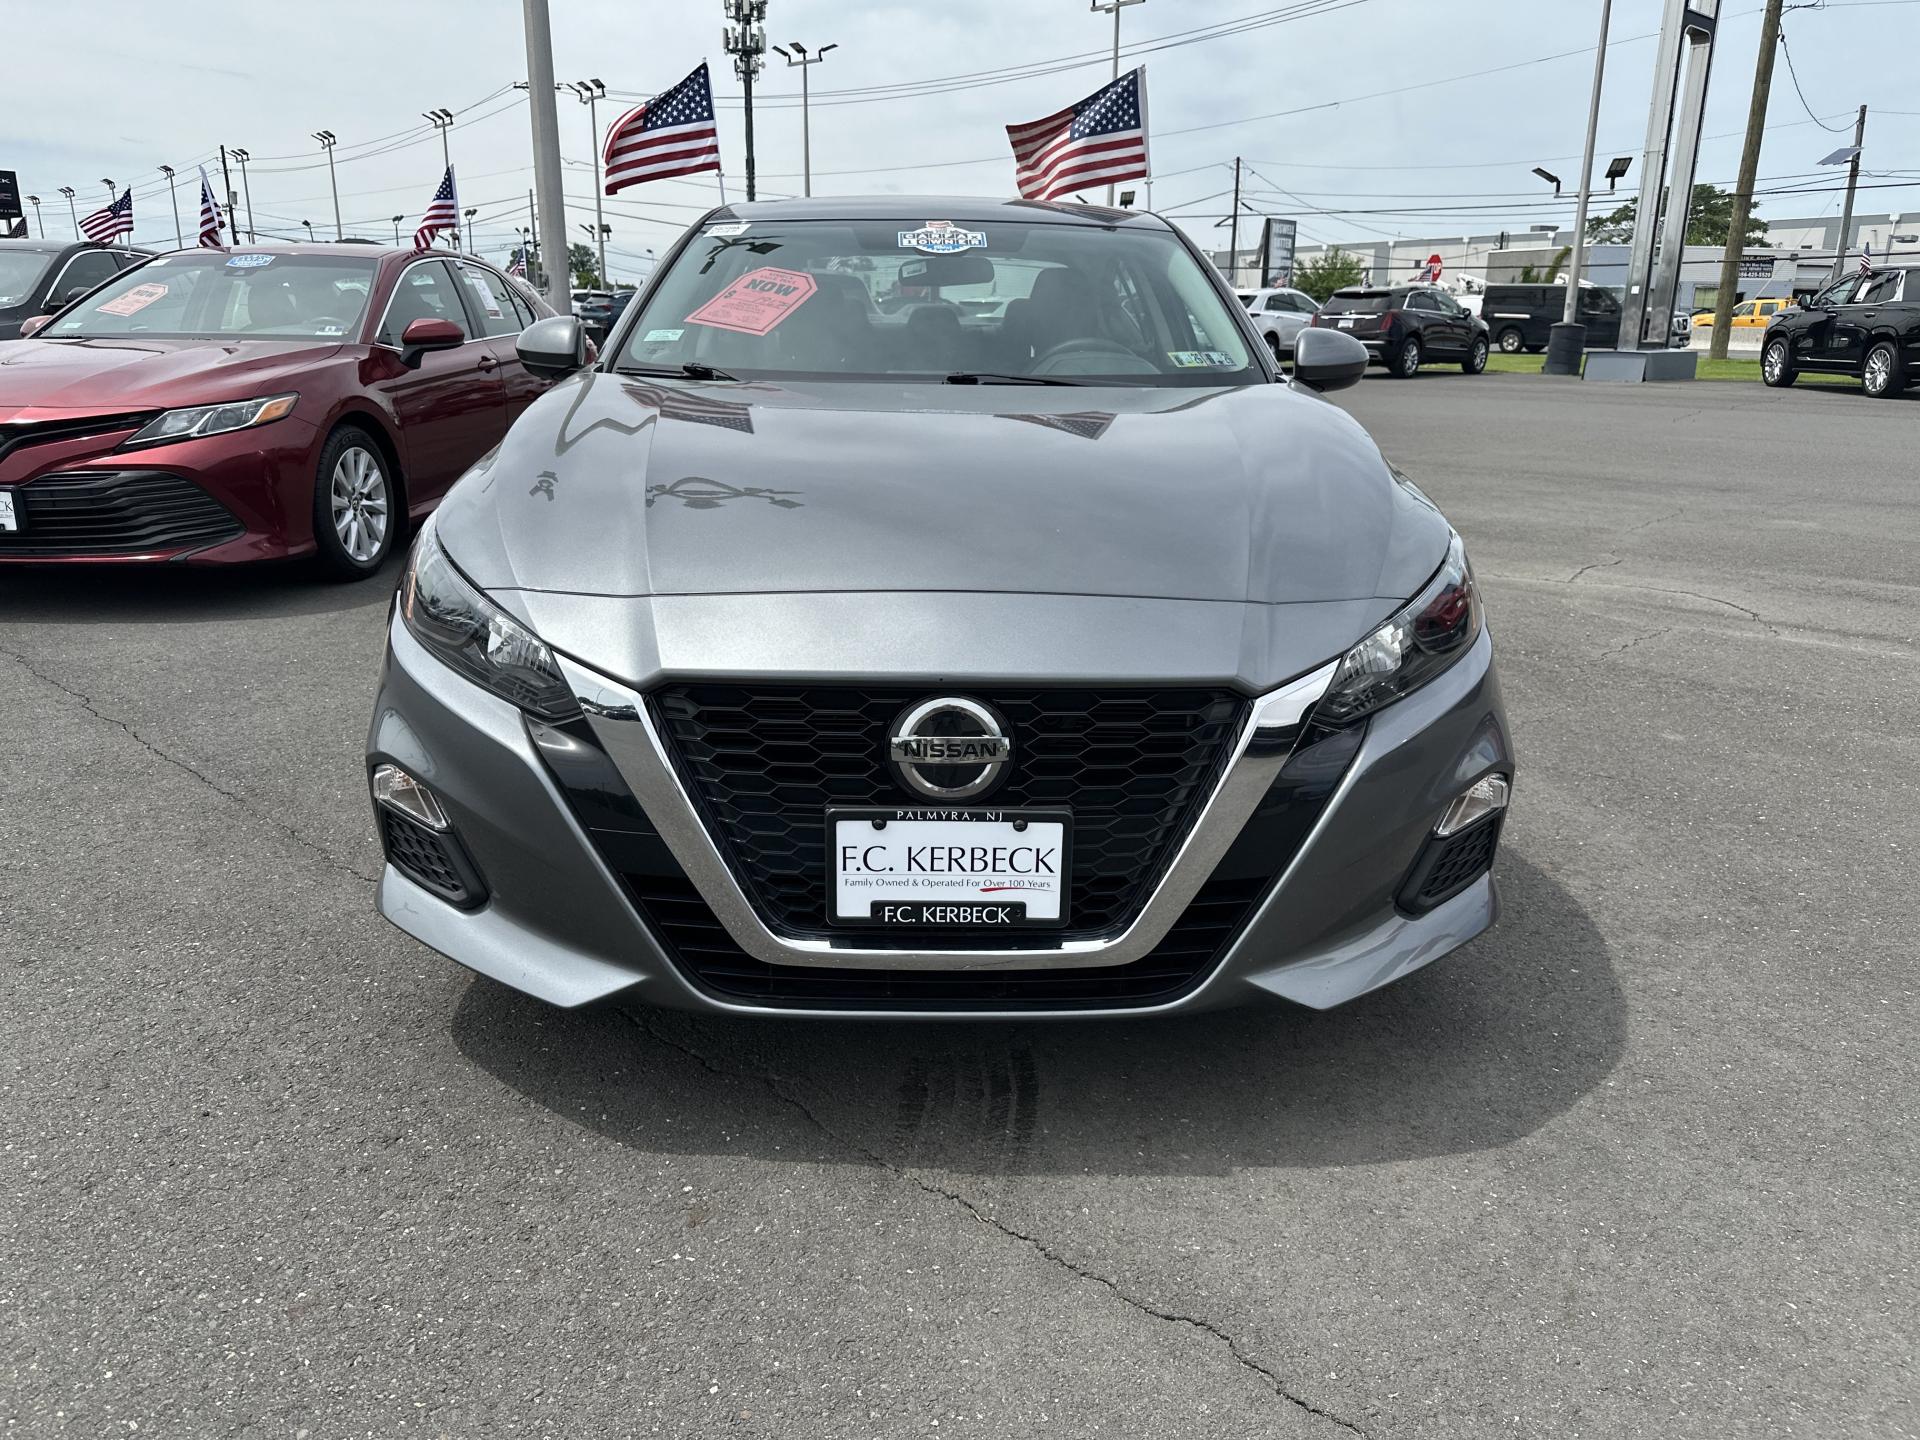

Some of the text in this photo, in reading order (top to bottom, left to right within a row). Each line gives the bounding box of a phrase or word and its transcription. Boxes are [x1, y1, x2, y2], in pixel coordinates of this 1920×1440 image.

[743, 278, 799, 297] NOW
[903, 741, 997, 758] NISSAN
[897, 811, 1003, 822] PALMYRA, NJ
[842, 845, 1056, 874] F.C. KERBECK
[844, 878, 1051, 889] Family Owned & Operated For Over 100 Years
[884, 906, 1011, 924] F.C. KERBECK
